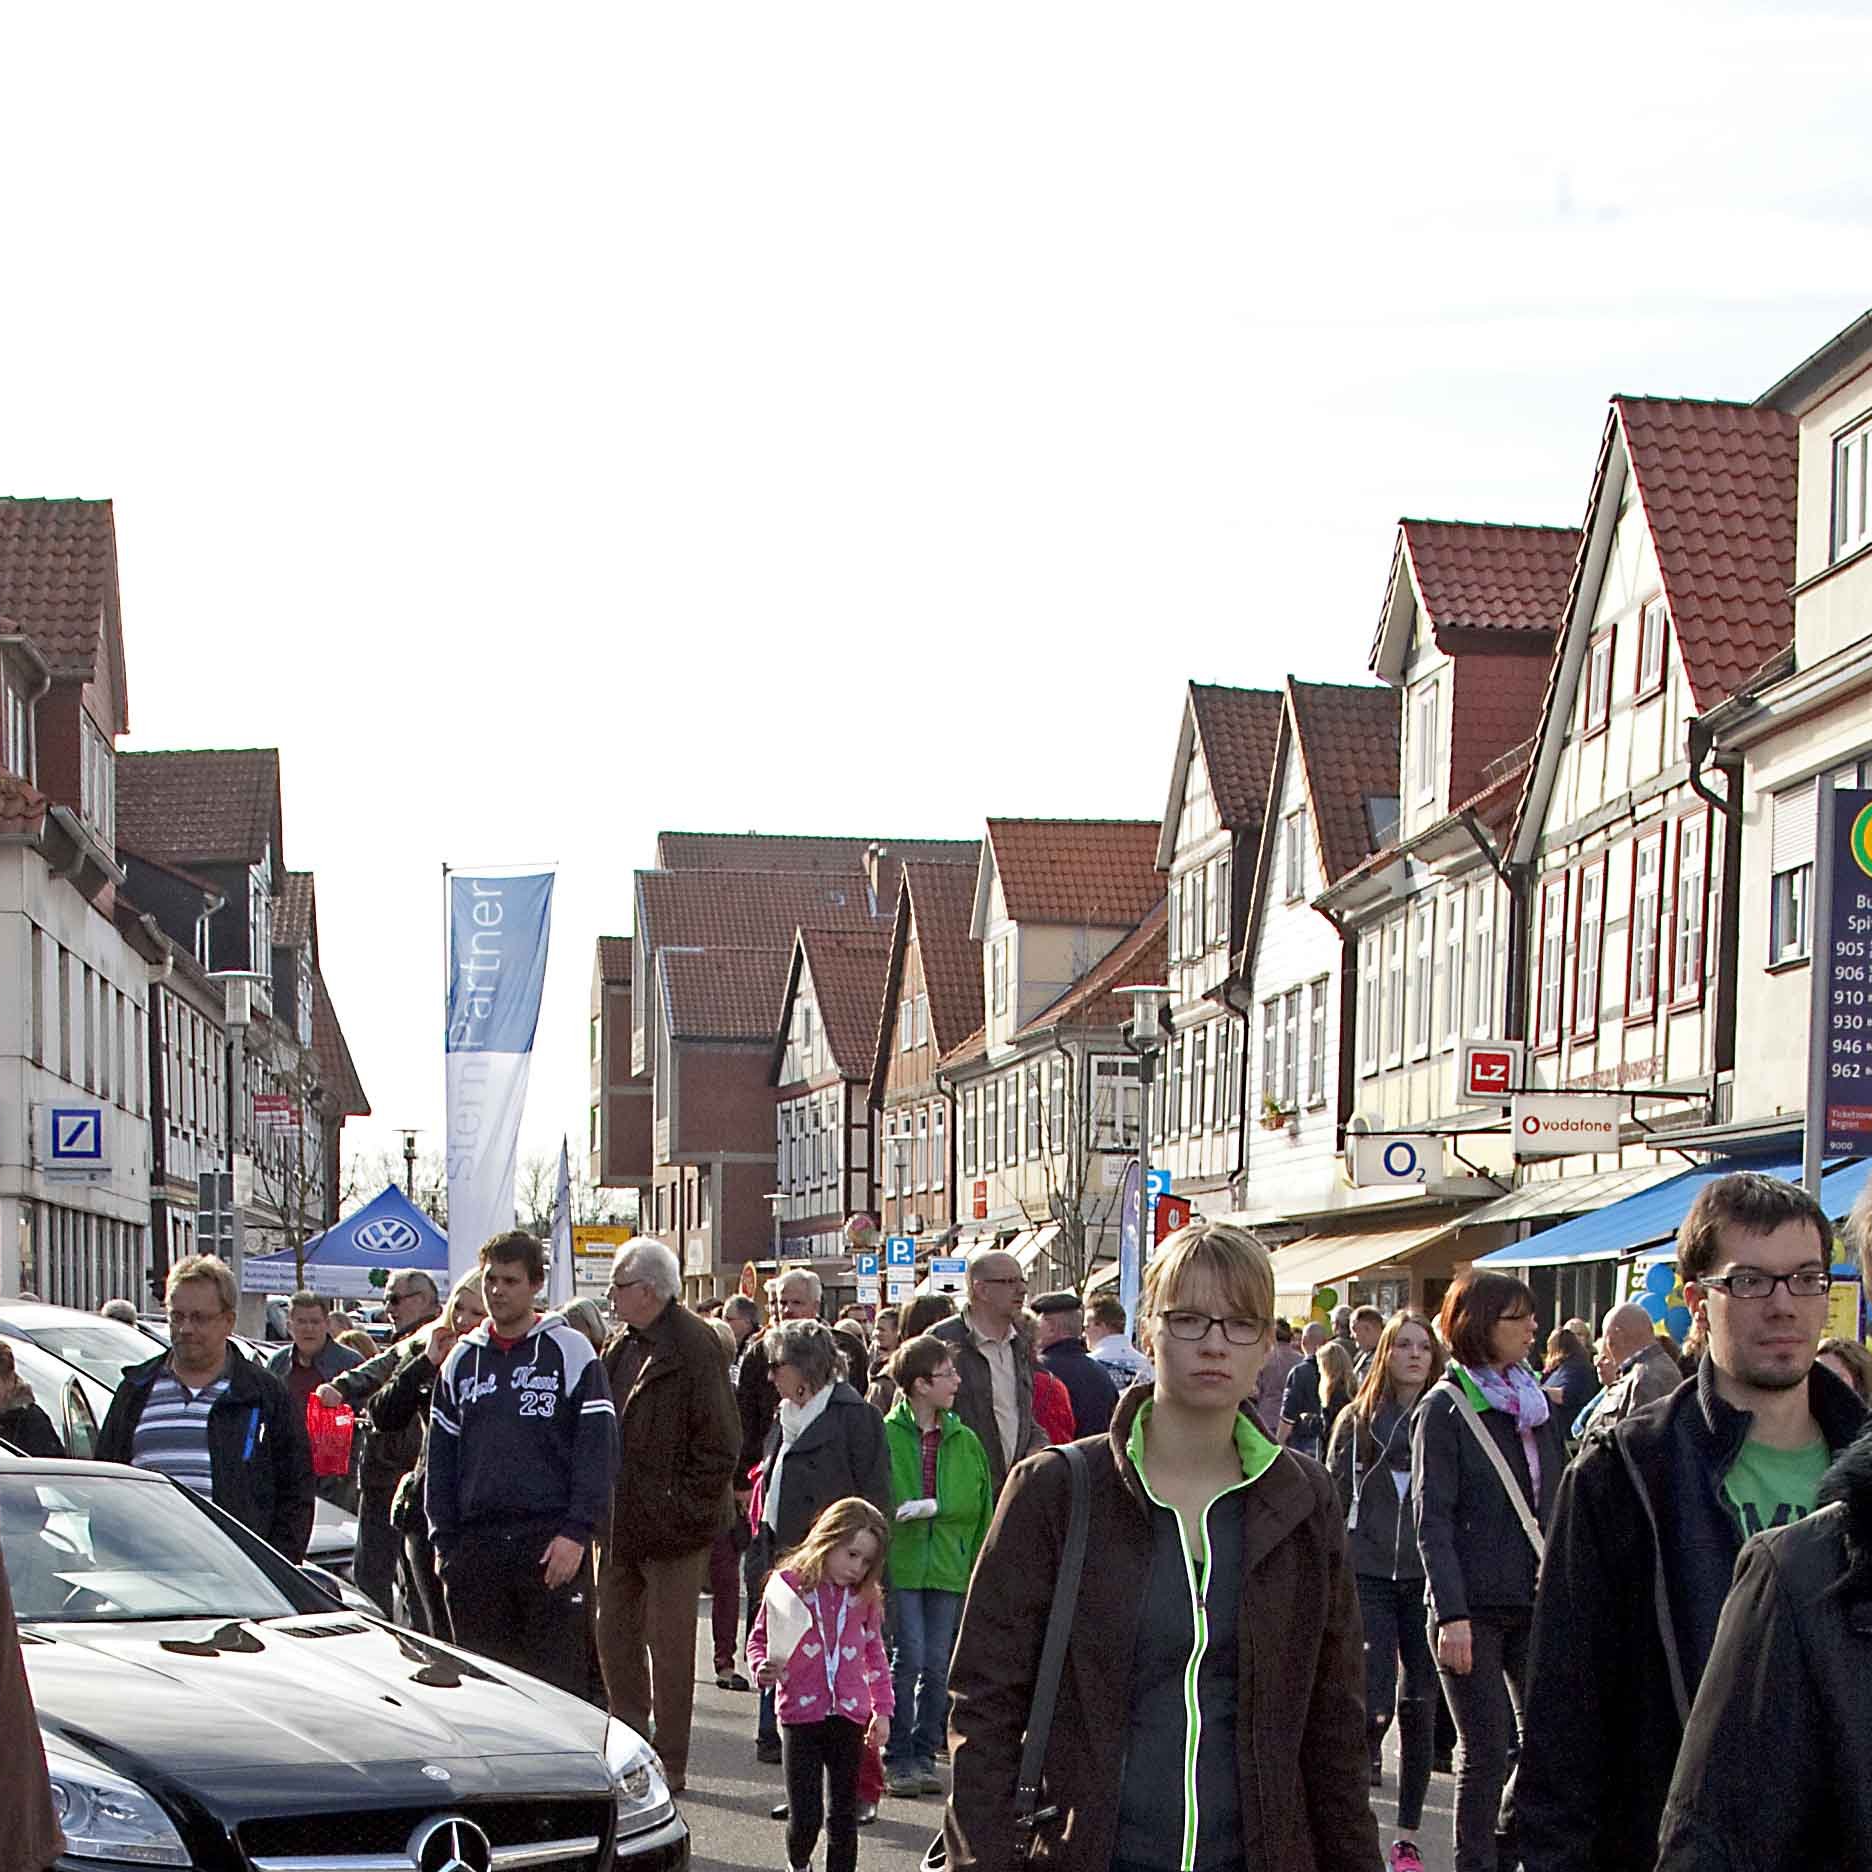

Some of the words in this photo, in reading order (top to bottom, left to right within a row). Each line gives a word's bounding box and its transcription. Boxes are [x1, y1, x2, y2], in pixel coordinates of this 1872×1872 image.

[1836, 941, 1865, 957] 905
[1835, 965, 1865, 981] 906
[1834, 990, 1864, 1006] 910
[1833, 1014, 1863, 1030] 930
[1832, 1039, 1863, 1054] 946
[1475, 1064, 1506, 1082] LZ
[1831, 1063, 1861, 1078] 962
[1543, 1118, 1612, 1133] vodafone
[893, 1240, 909, 1263] P
[862, 1257, 874, 1273] P
[519, 1391, 557, 1418] 23
